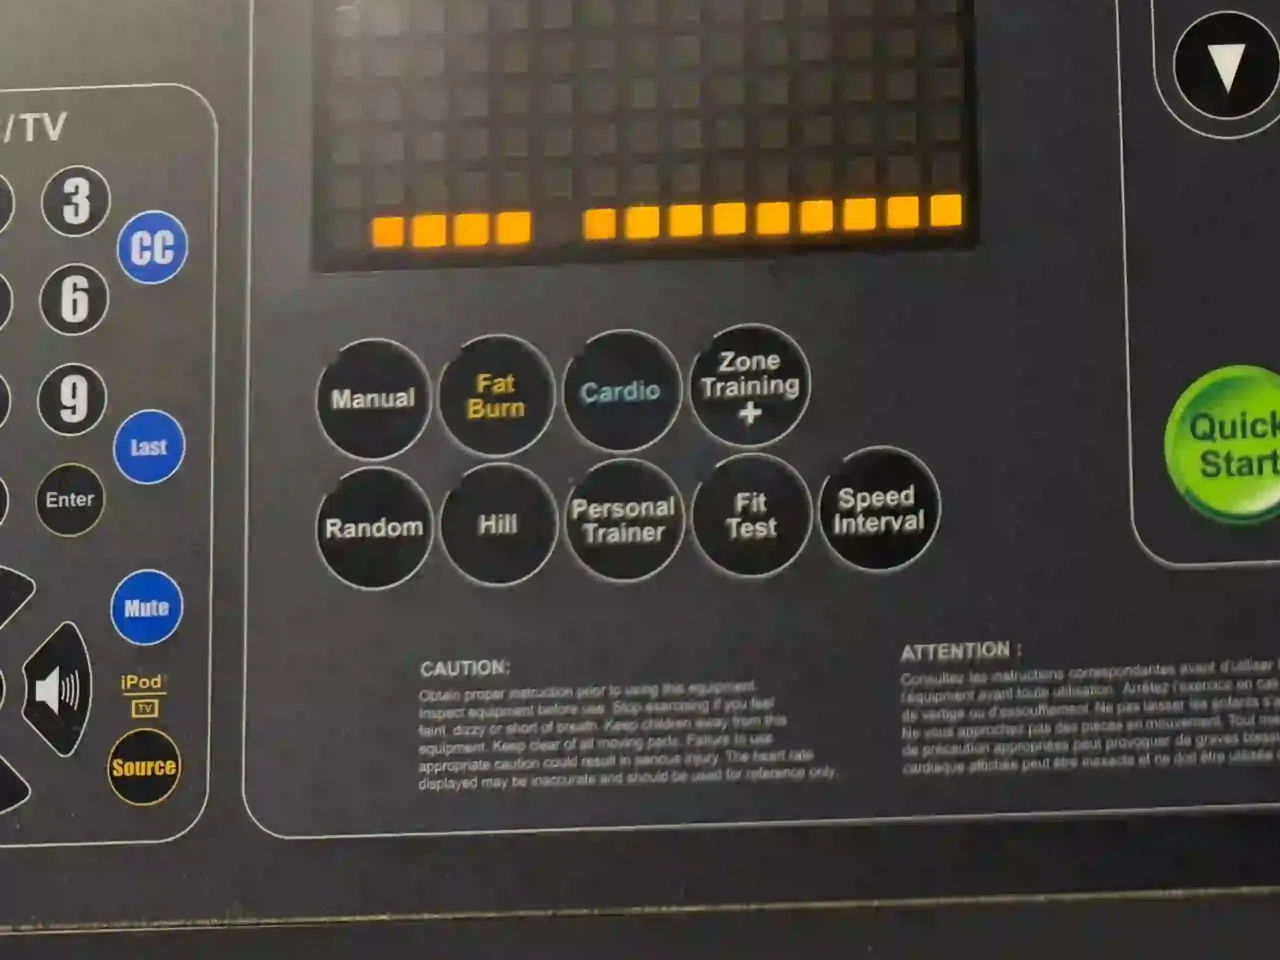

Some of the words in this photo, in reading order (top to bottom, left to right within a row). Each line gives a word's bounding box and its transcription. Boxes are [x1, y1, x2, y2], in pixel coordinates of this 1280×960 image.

[63, 177, 91, 225] 3
[130, 230, 175, 266] CC
[61, 275, 89, 323] 6
[720, 351, 781, 374] Zone
[476, 374, 515, 394] Fat
[580, 380, 661, 404] Cardio
[701, 373, 801, 399] Training
[60, 374, 88, 423] 9
[332, 387, 415, 411] Manual
[468, 397, 526, 419] Burn
[131, 439, 168, 457] Last
[46, 491, 96, 508] Enter
[572, 496, 675, 520] Personal
[736, 492, 768, 514] Fit
[839, 485, 916, 511] Speed
[326, 516, 425, 539] Random
[478, 512, 518, 535] Hill
[585, 521, 666, 544] Trainer
[726, 517, 777, 539] Test
[834, 510, 925, 534] Interval
[124, 599, 170, 618] Mute
[902, 640, 1010, 662] ATTENTION
[420, 659, 511, 677] CAUTION:
[121, 674, 162, 691] iPod
[112, 757, 177, 778] Source
